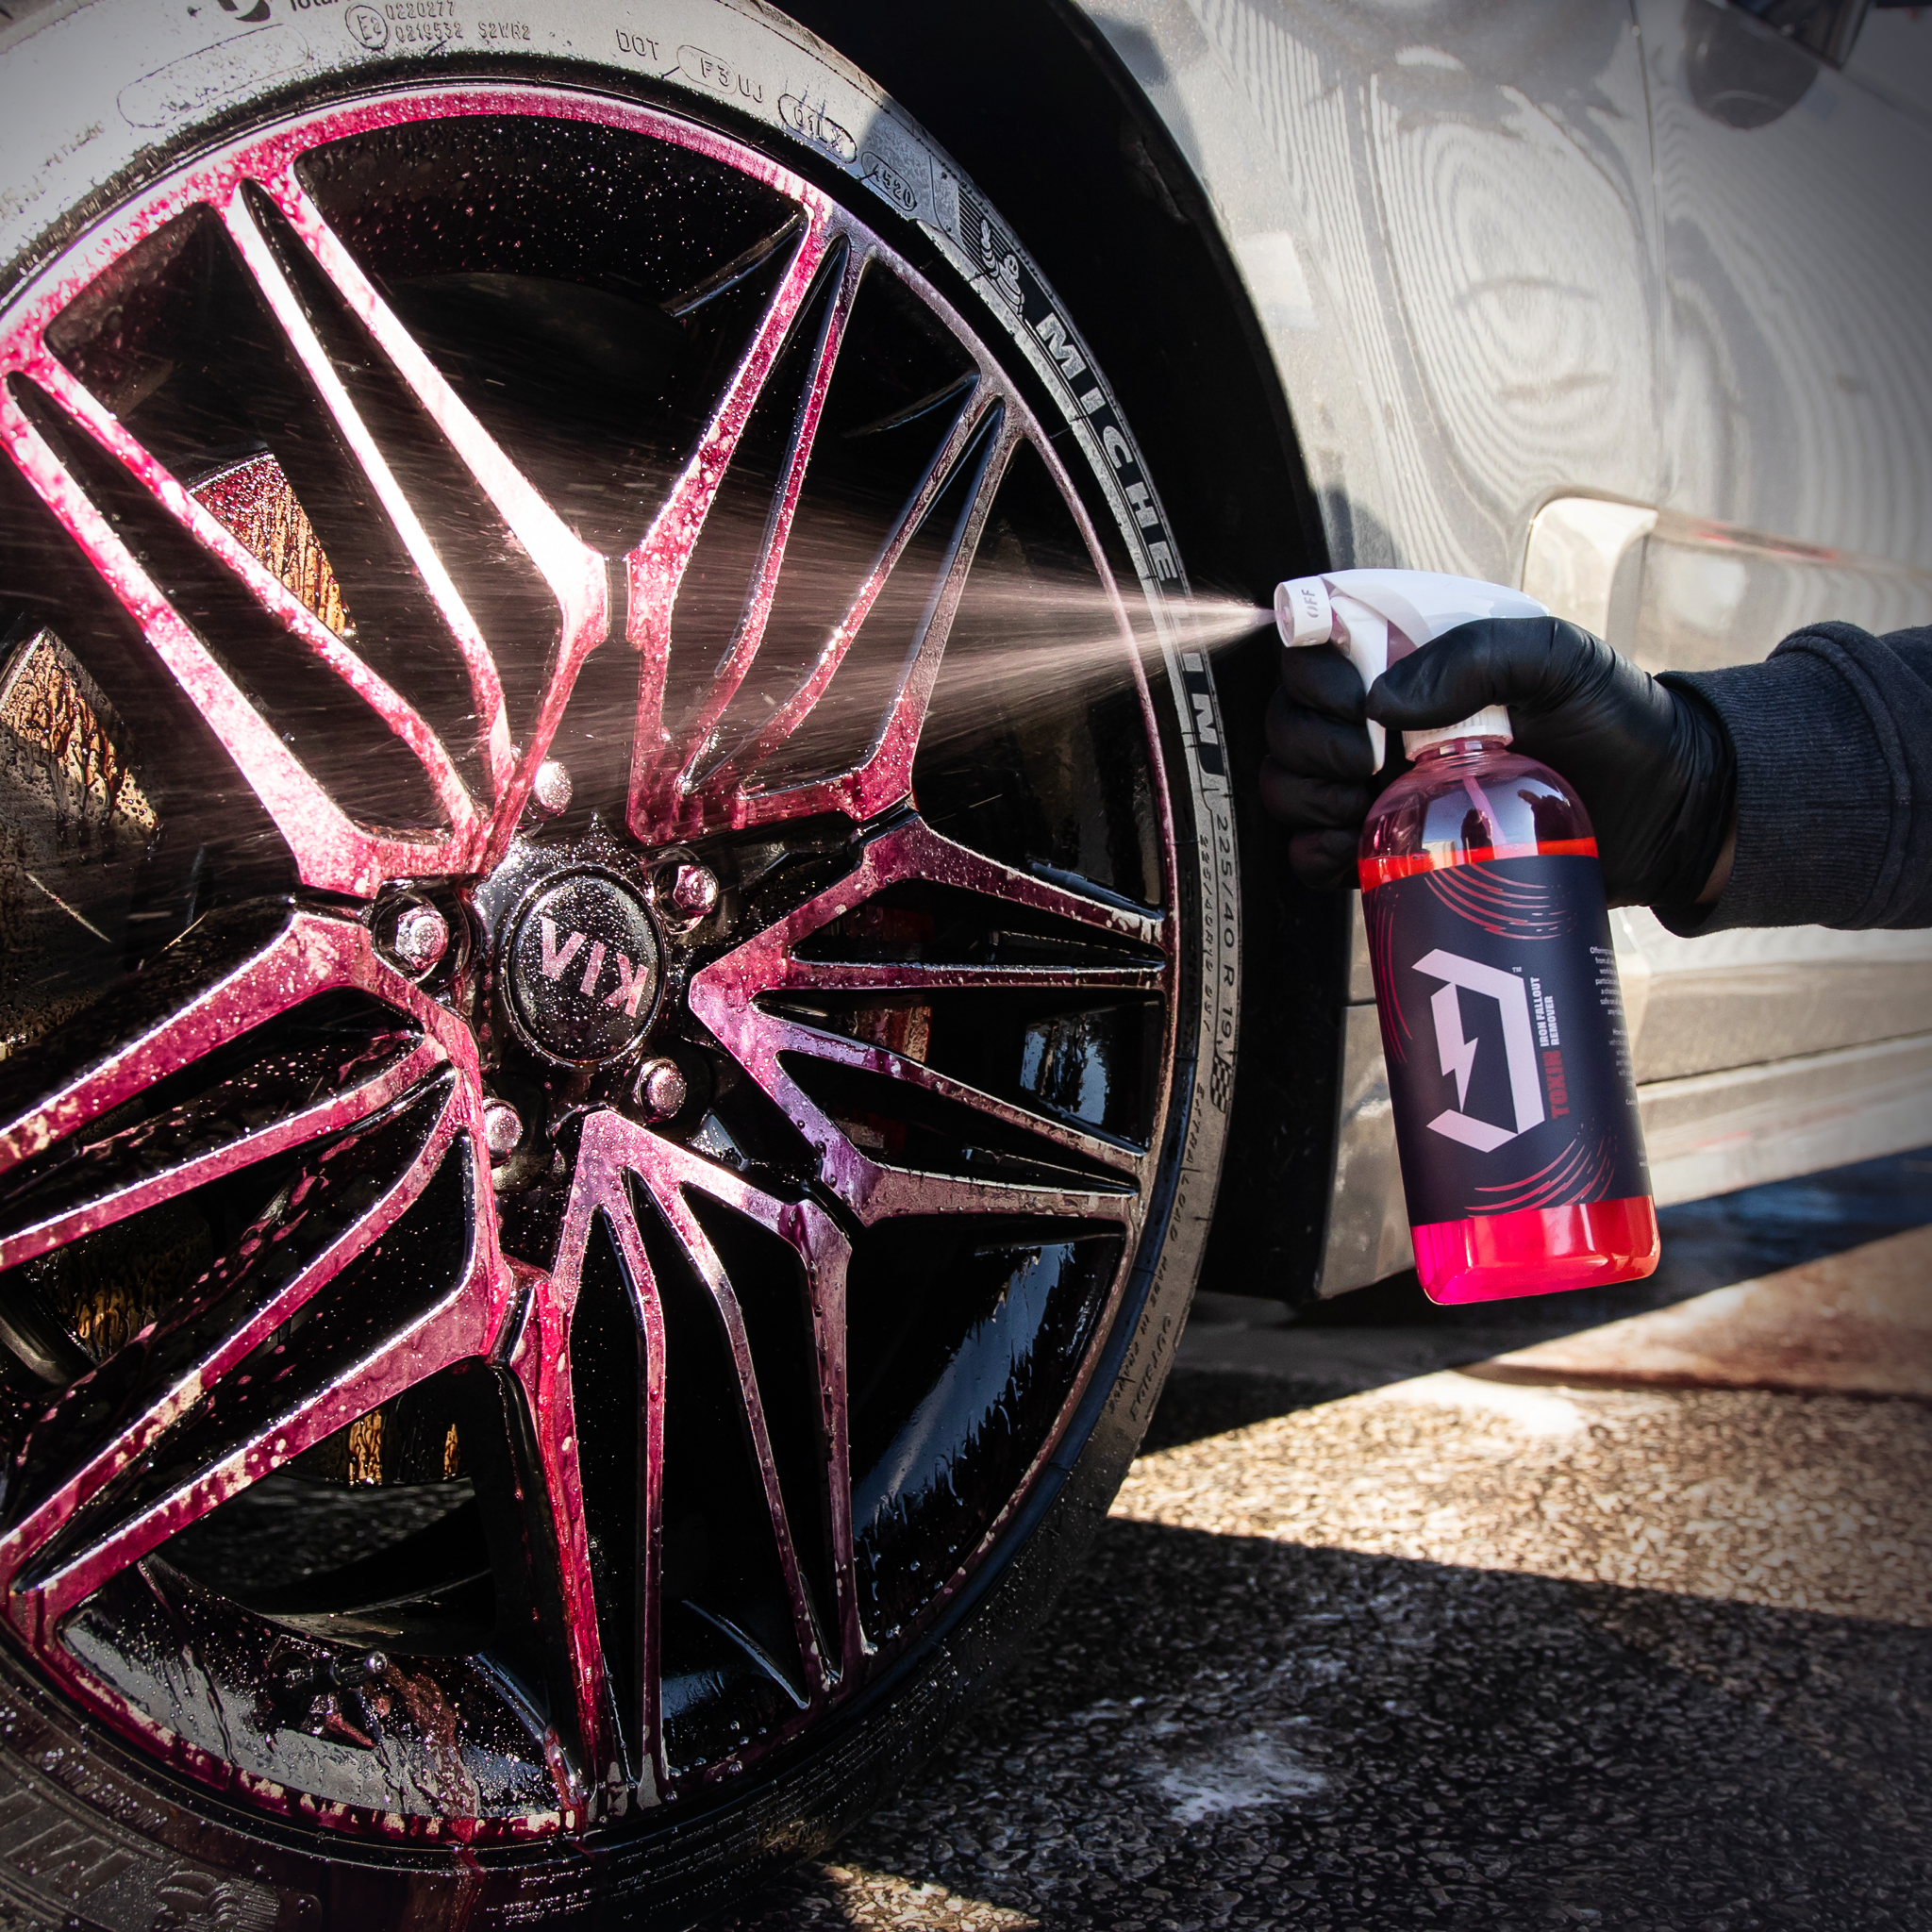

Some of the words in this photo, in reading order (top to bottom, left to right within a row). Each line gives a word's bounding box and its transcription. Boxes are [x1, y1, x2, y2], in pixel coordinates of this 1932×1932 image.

[616, 29, 659, 61] DOT
[1301, 589, 1319, 618] OFF
[1217, 814, 1235, 948] 225/40
[1224, 963, 1235, 987] R
[1530, 976, 1546, 1020] FALLOUT
[1222, 1007, 1233, 1039] 19
[1537, 1021, 1549, 1047] IRON
[1543, 995, 1560, 1046] REMOVER
[1542, 1050, 1570, 1120] TOXIN
[1170, 1174, 1189, 1241] LOAD
